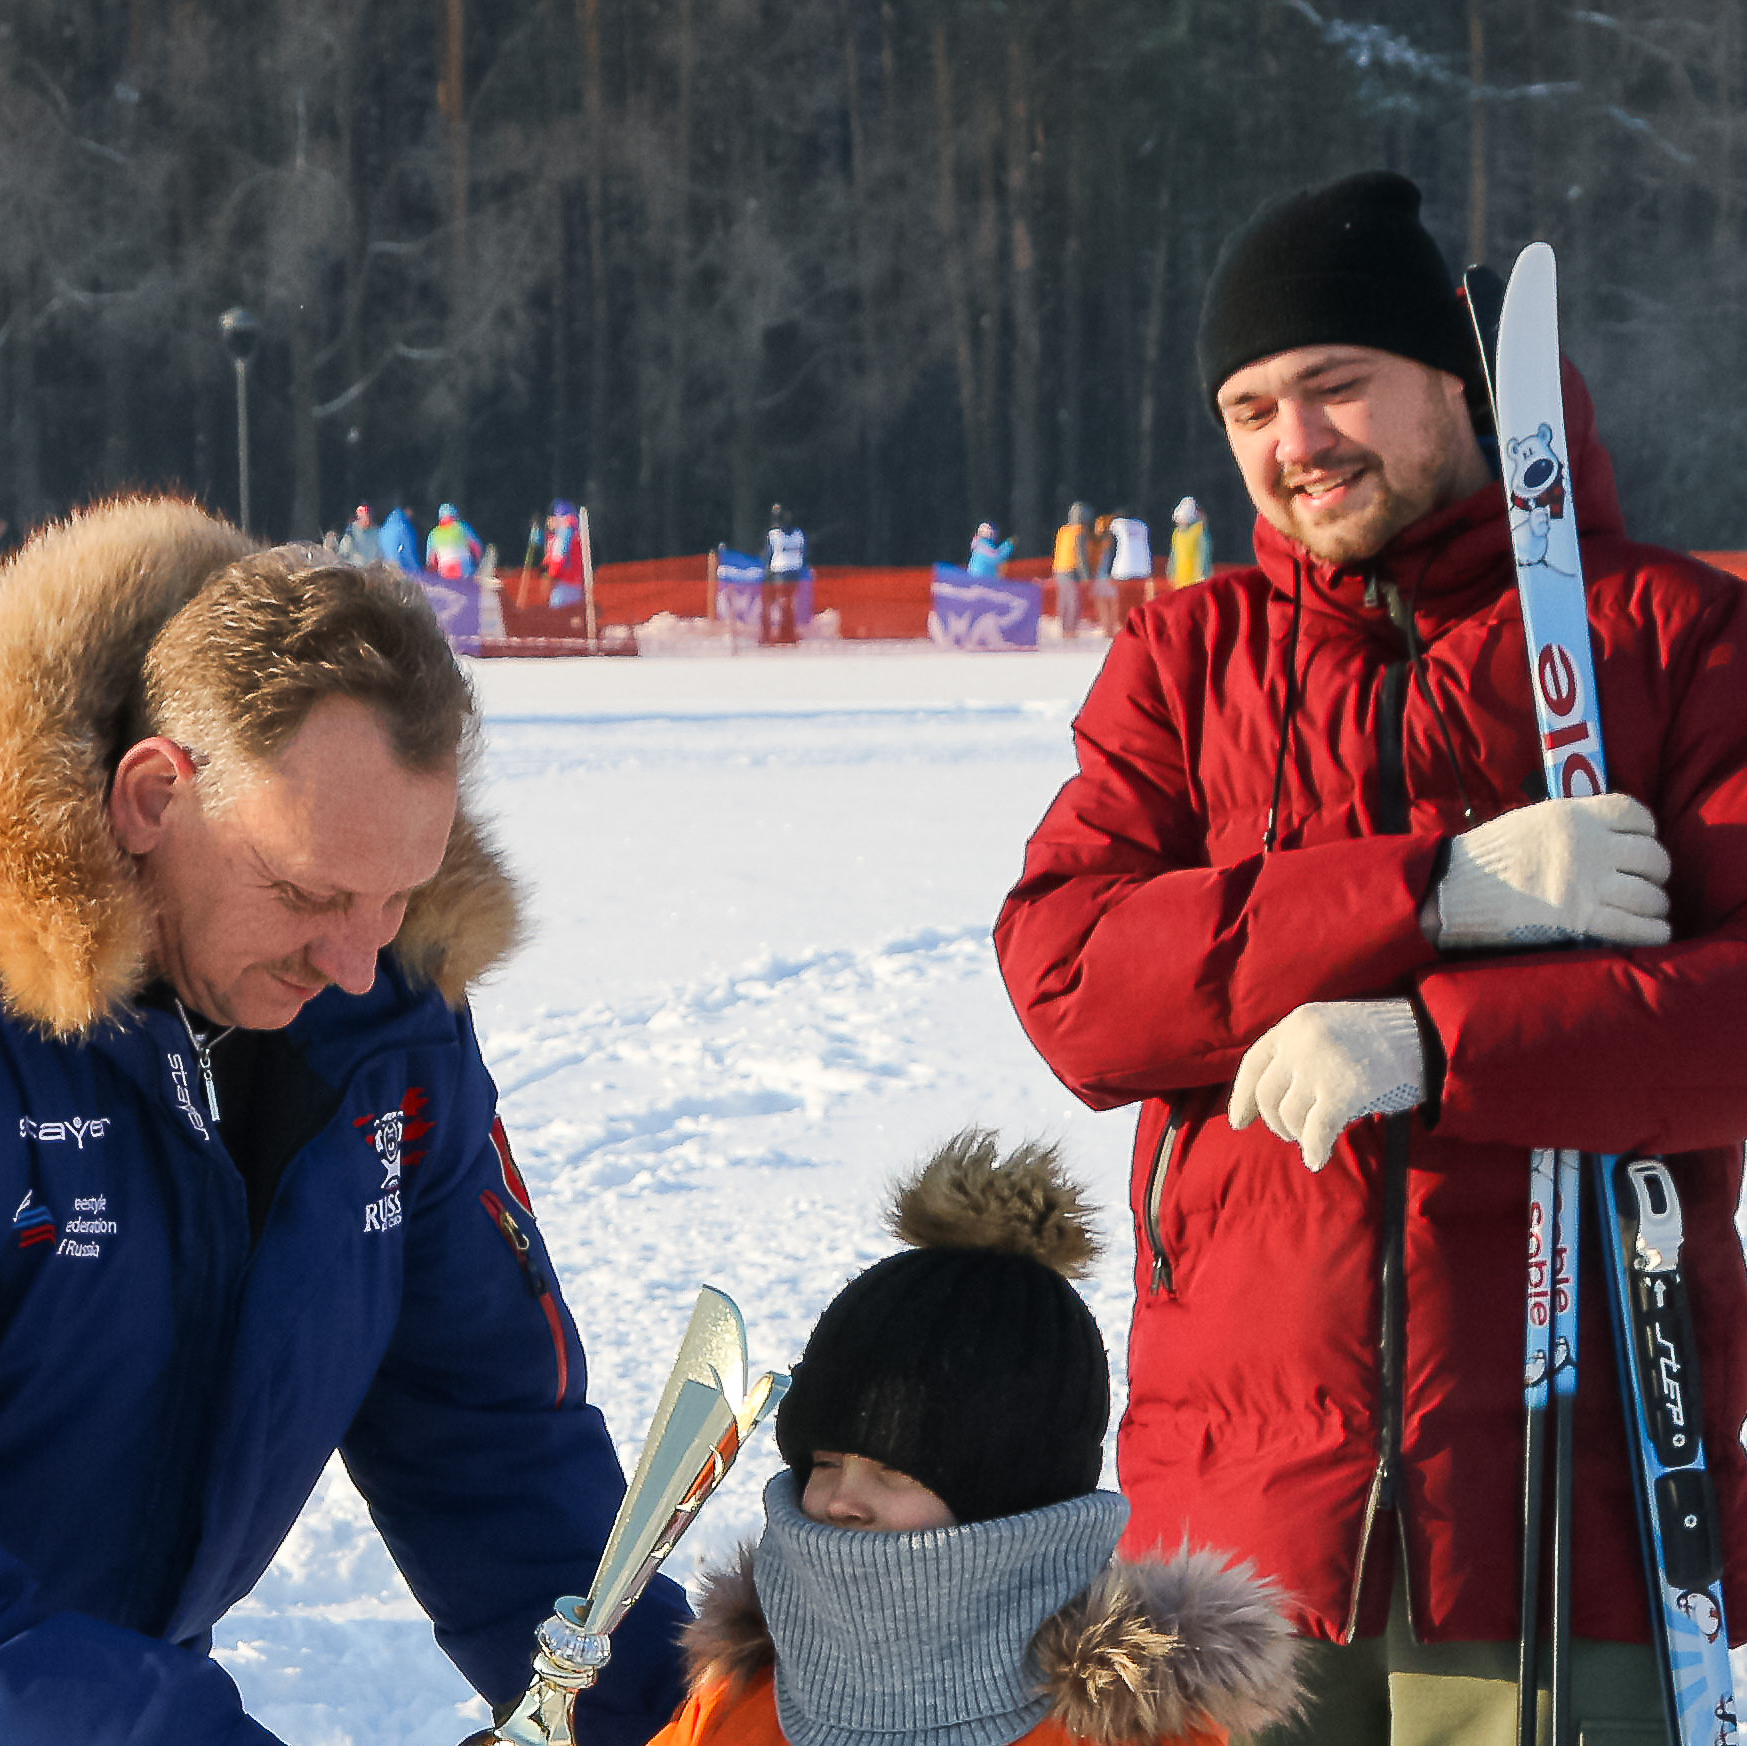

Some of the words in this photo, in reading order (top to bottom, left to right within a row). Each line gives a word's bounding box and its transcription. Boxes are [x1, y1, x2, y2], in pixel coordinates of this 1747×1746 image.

[363, 1189, 402, 1233] RUSS
[65, 1215, 118, 1235] ederation
[65, 1239, 101, 1258] Russia
